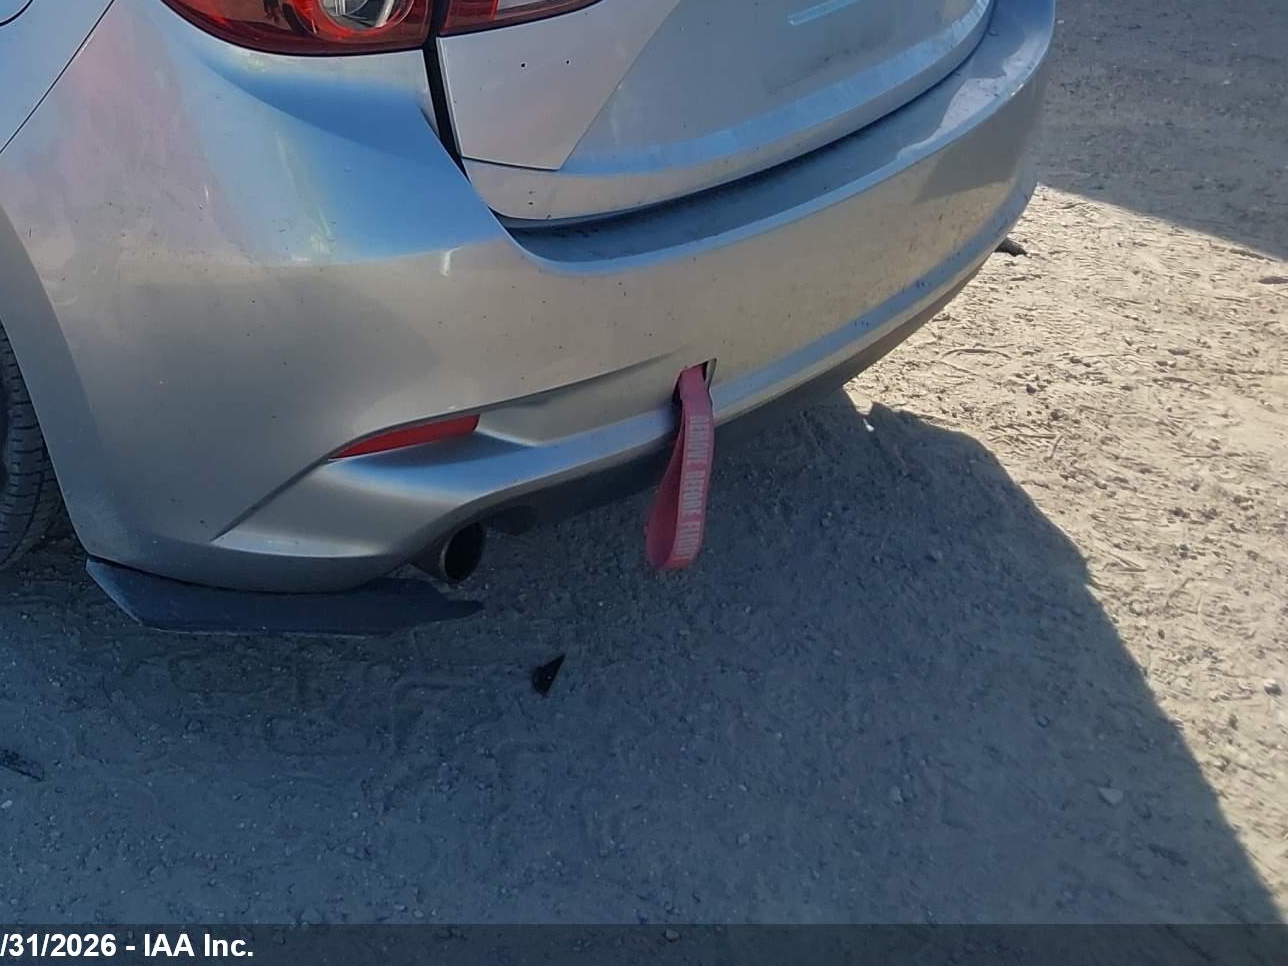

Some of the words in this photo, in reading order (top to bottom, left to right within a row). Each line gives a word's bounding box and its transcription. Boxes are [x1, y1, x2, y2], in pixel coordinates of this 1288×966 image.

[686, 414, 710, 466] REMOVE
[681, 470, 706, 516] BEFORE
[675, 520, 701, 561] FLIGHT
